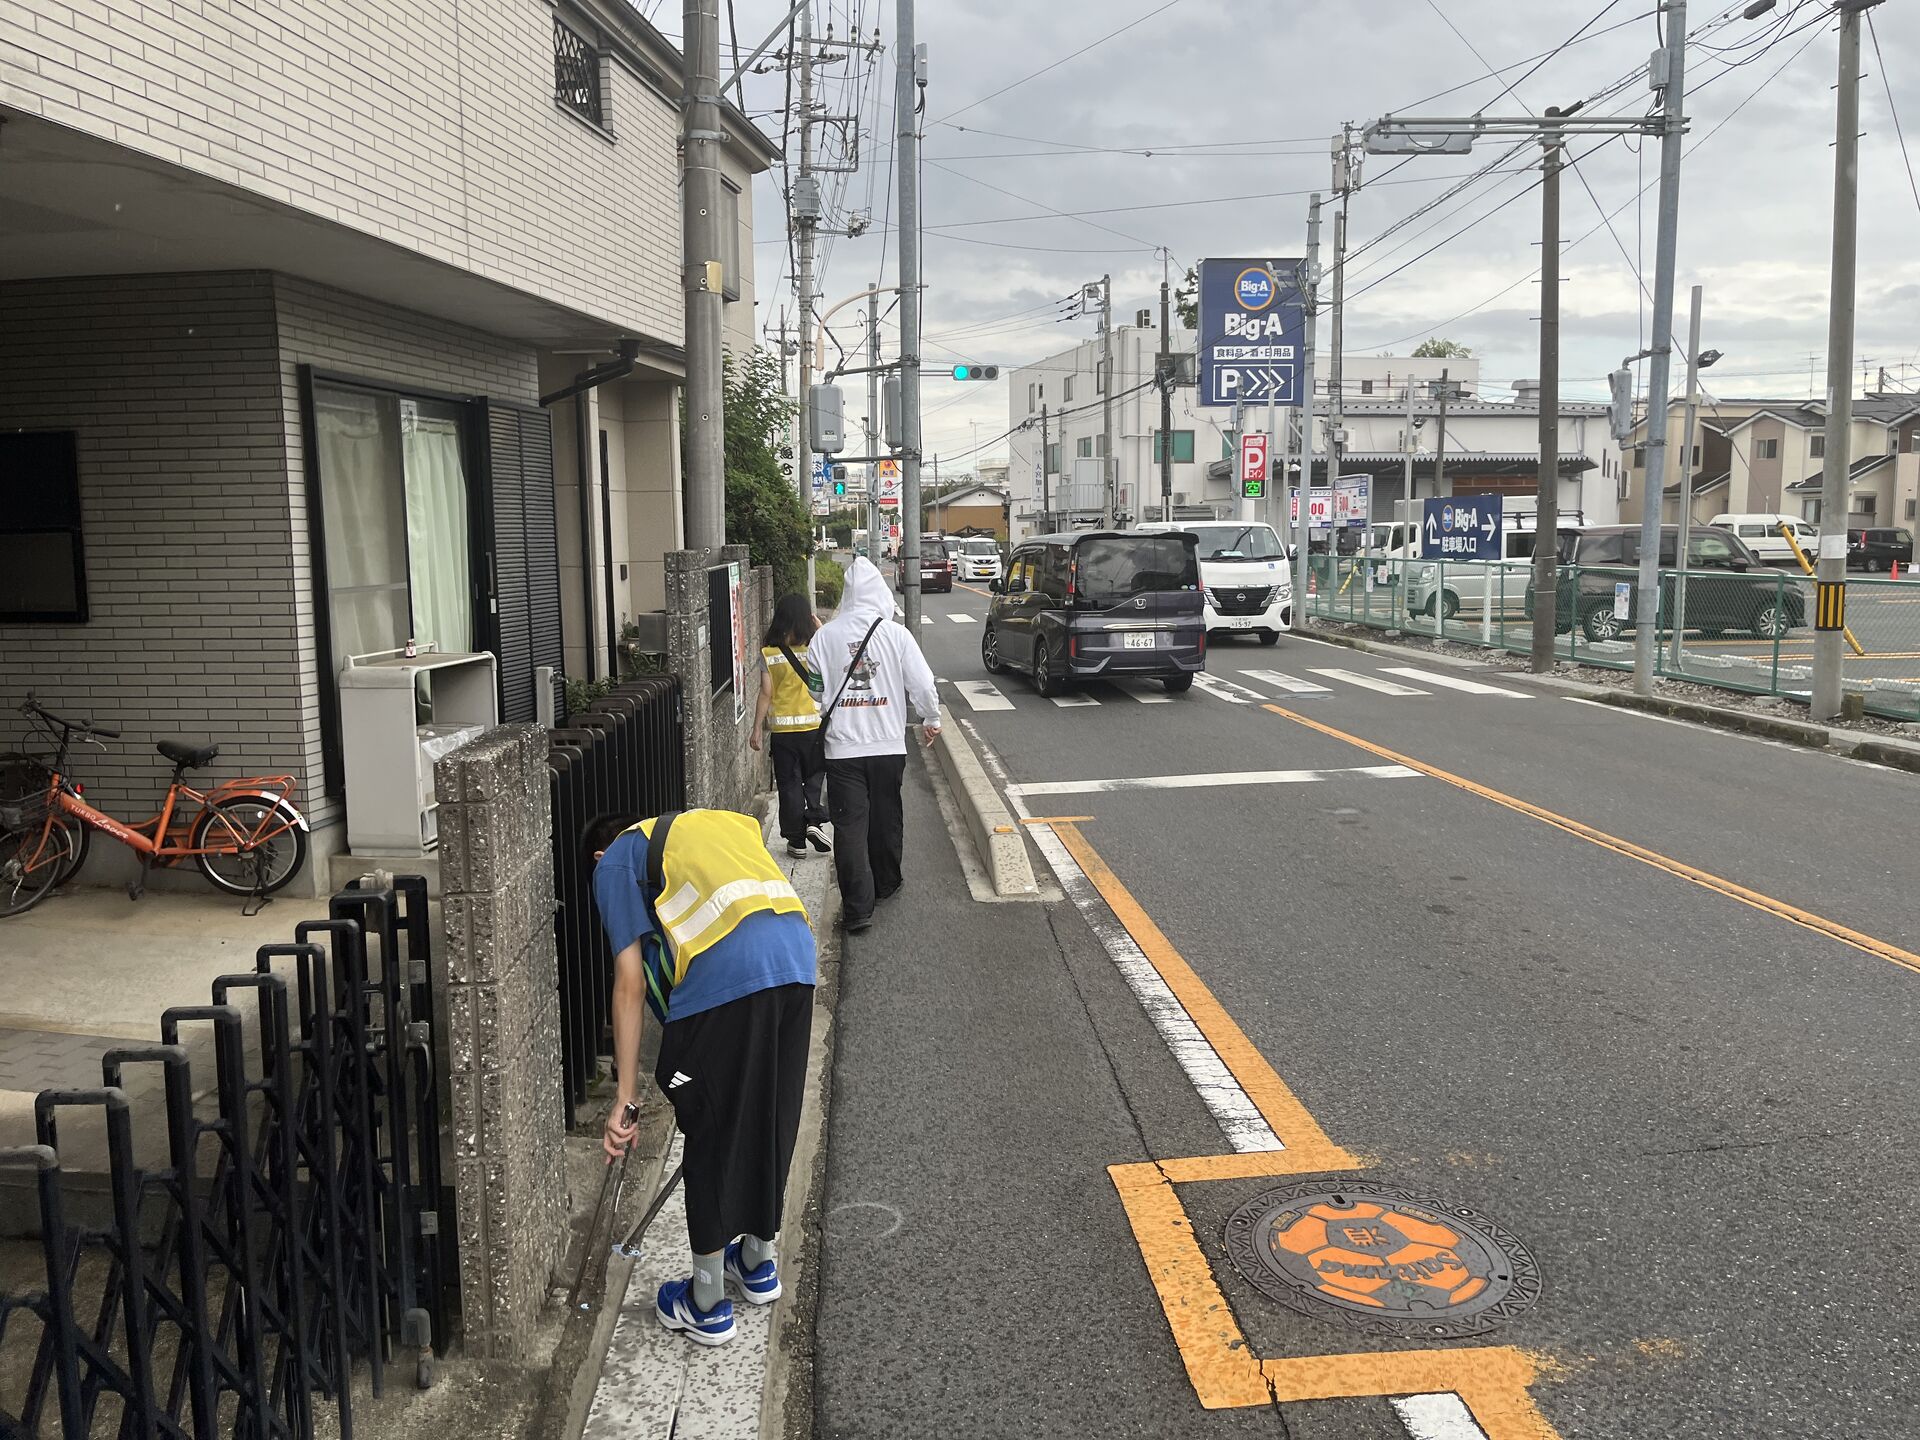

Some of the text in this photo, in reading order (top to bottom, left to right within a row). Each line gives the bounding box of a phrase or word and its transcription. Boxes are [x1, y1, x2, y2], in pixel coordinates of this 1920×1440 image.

[1224, 313, 1283, 341] Big-A
[1221, 368, 1240, 397] P
[1244, 447, 1264, 479] P
[1249, 470, 1263, 478] コイン
[1245, 480, 1261, 496] 空
[1455, 507, 1478, 532] Big-A
[1441, 536, 1477, 553] 駐車場入口
